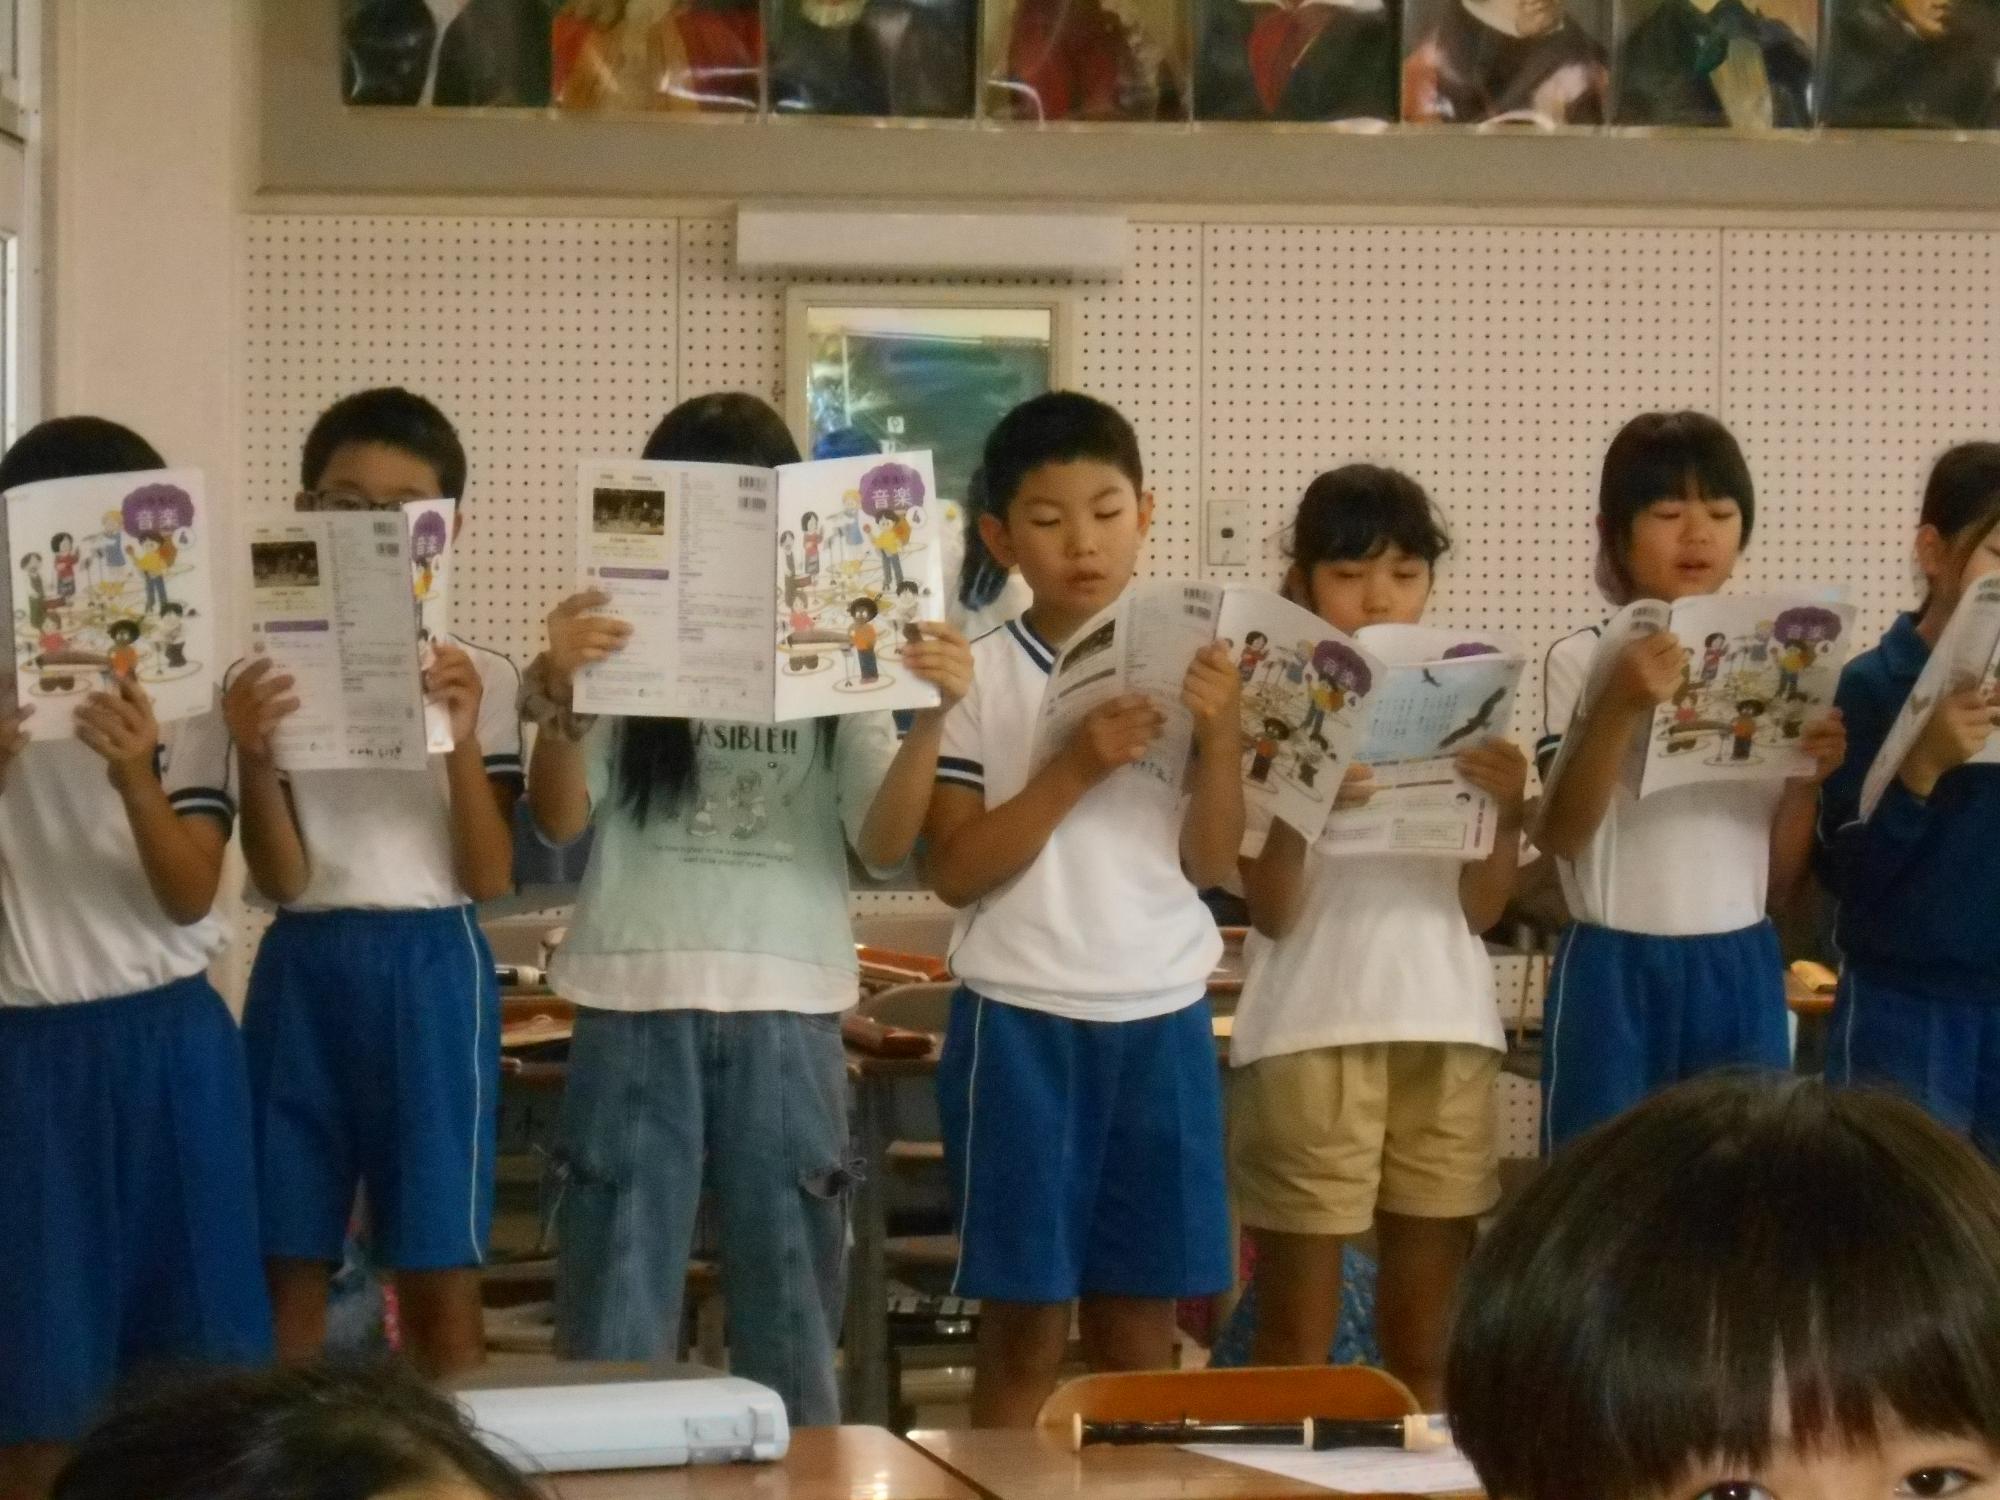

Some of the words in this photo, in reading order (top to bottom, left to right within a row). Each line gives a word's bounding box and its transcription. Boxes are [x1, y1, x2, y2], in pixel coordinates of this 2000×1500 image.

[871, 486, 913, 509] 音楽
[911, 510, 921, 523] 4
[695, 721, 797, 755] ASIBLE!!
